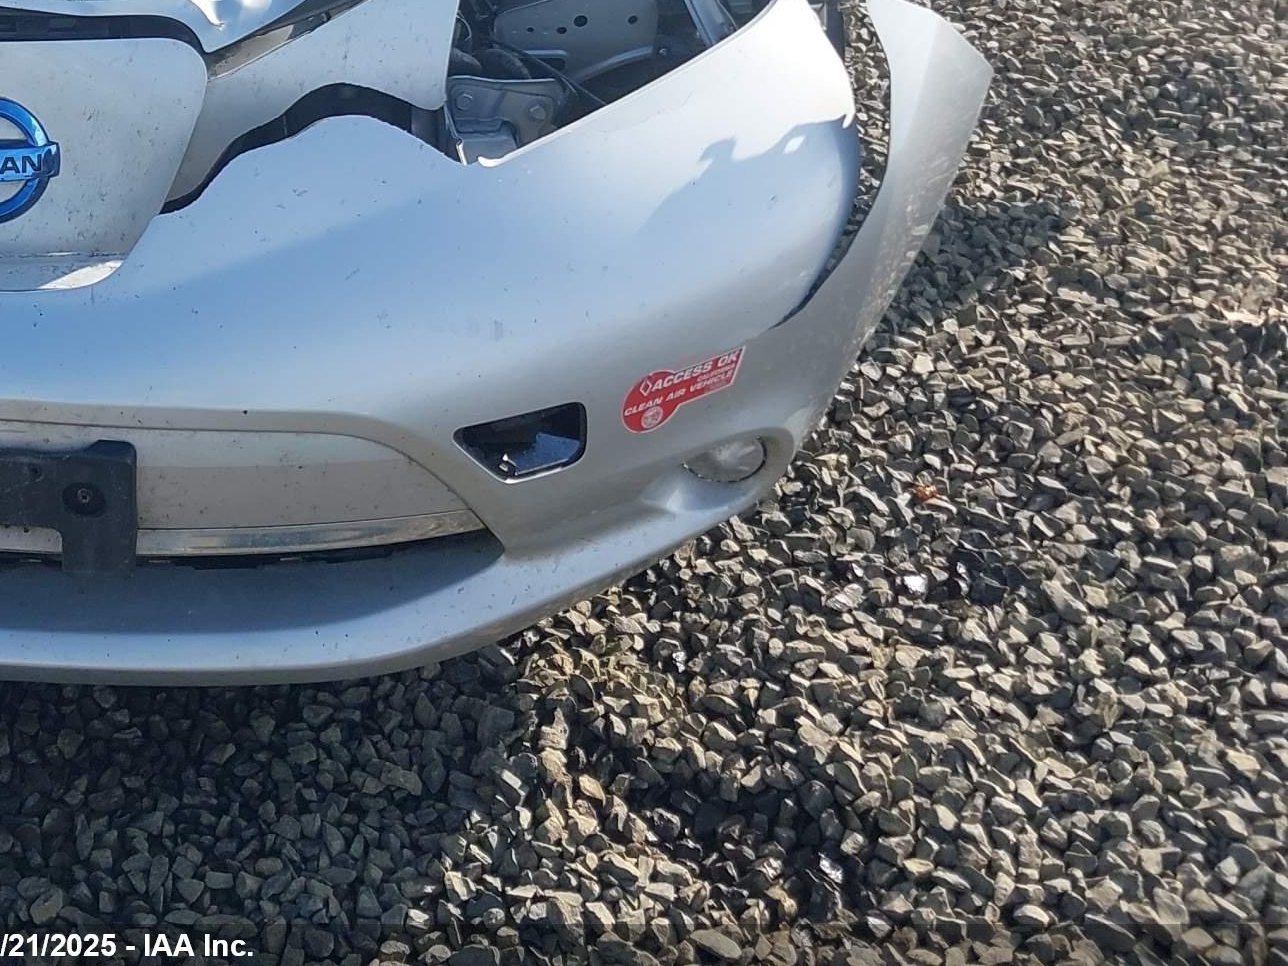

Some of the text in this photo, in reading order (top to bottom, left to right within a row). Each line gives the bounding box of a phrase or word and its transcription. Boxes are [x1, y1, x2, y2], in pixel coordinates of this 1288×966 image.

[623, 396, 664, 417] CLEAN
[665, 388, 686, 402] AIR
[689, 369, 734, 393] VEHICLE
[651, 361, 713, 392] ACCESS
[716, 351, 740, 368] OK
